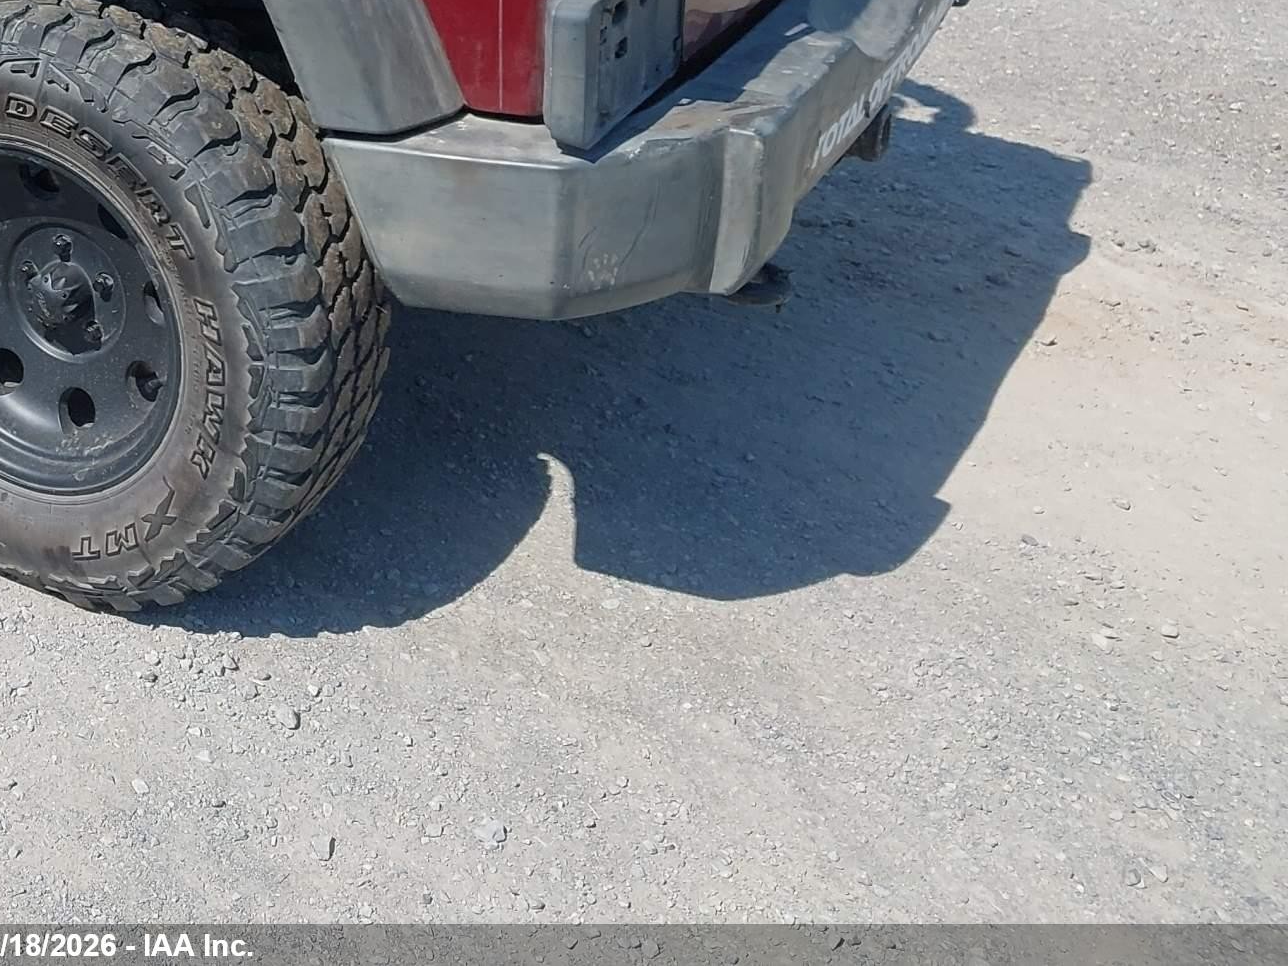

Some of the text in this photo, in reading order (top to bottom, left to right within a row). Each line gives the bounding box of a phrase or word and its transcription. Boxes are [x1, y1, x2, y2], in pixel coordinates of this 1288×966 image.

[4, 91, 227, 561] DESERT HAWK XMT
